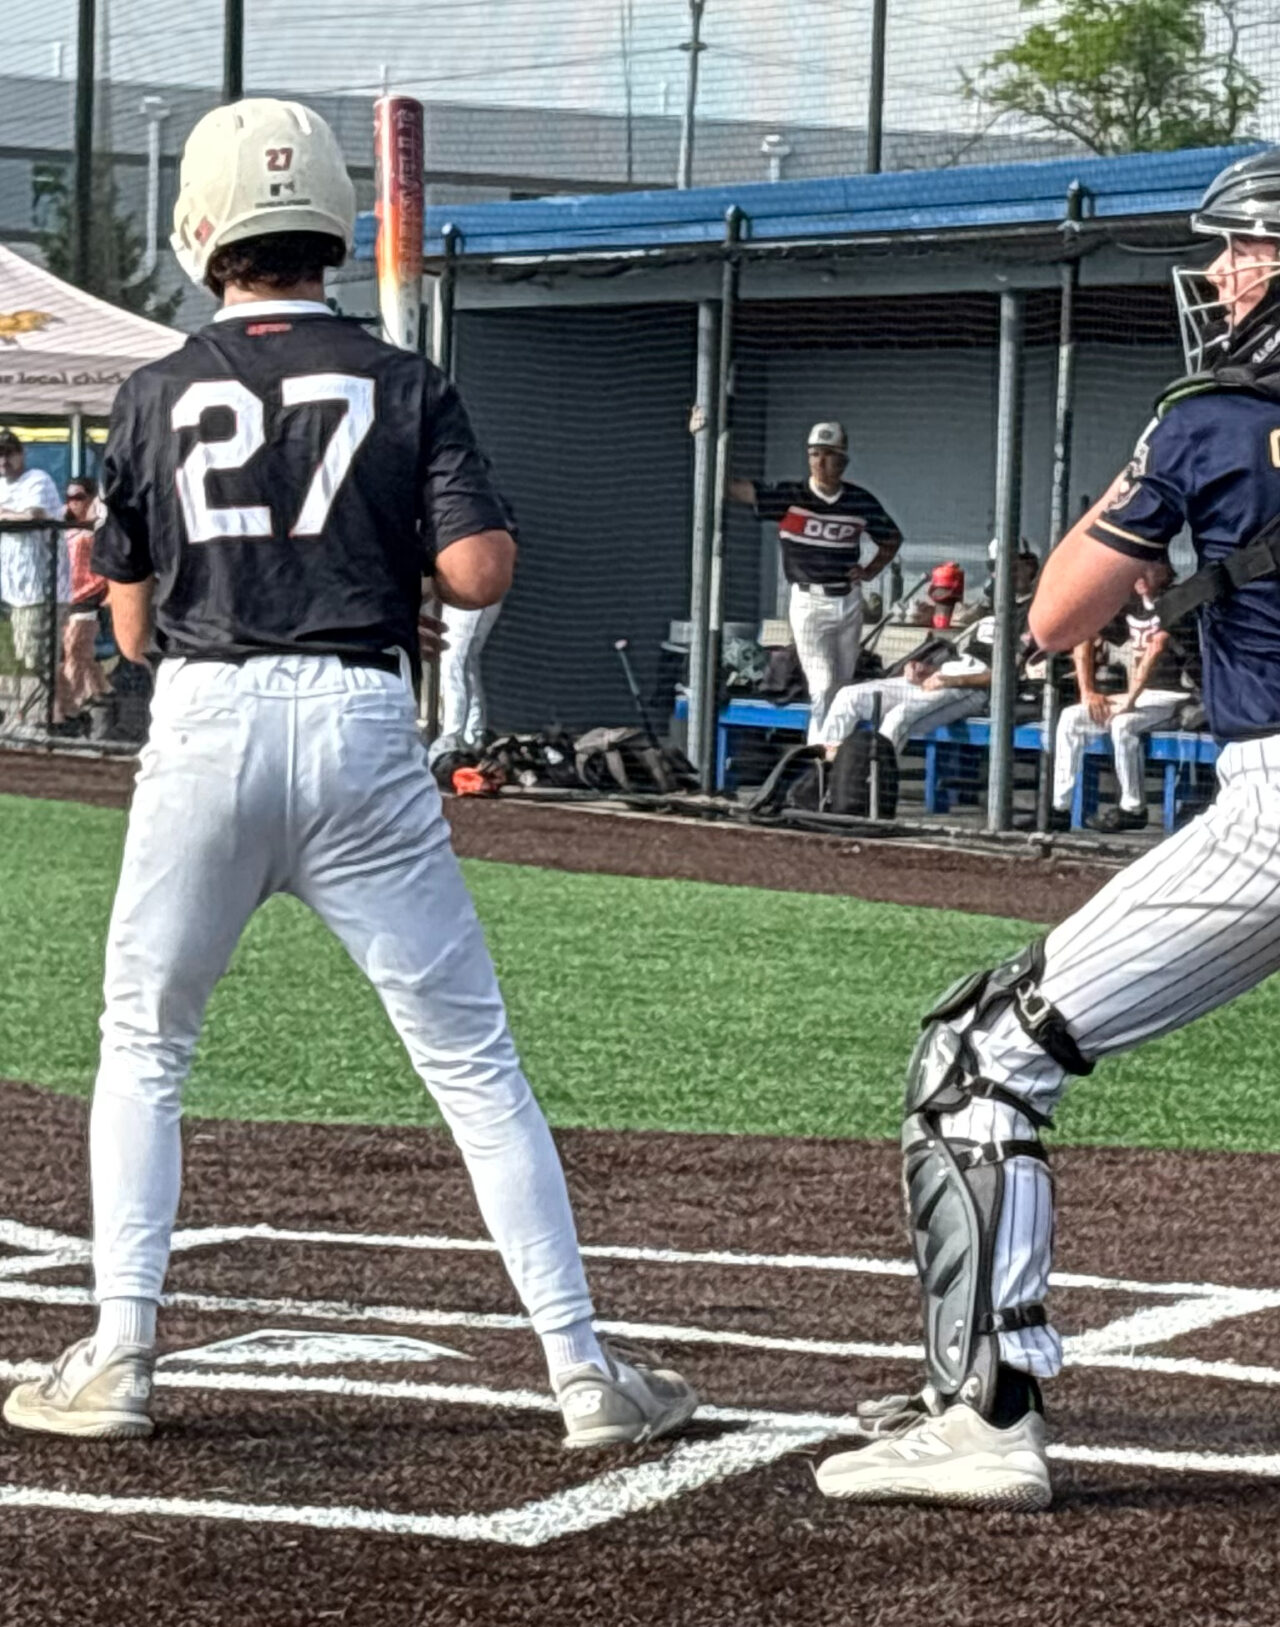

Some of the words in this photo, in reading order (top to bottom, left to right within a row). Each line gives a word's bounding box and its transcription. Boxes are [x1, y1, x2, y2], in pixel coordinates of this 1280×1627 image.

[265, 148, 293, 171] 27
[18, 371, 68, 385] local
[171, 373, 375, 543] 27
[803, 519, 856, 540] DCP
